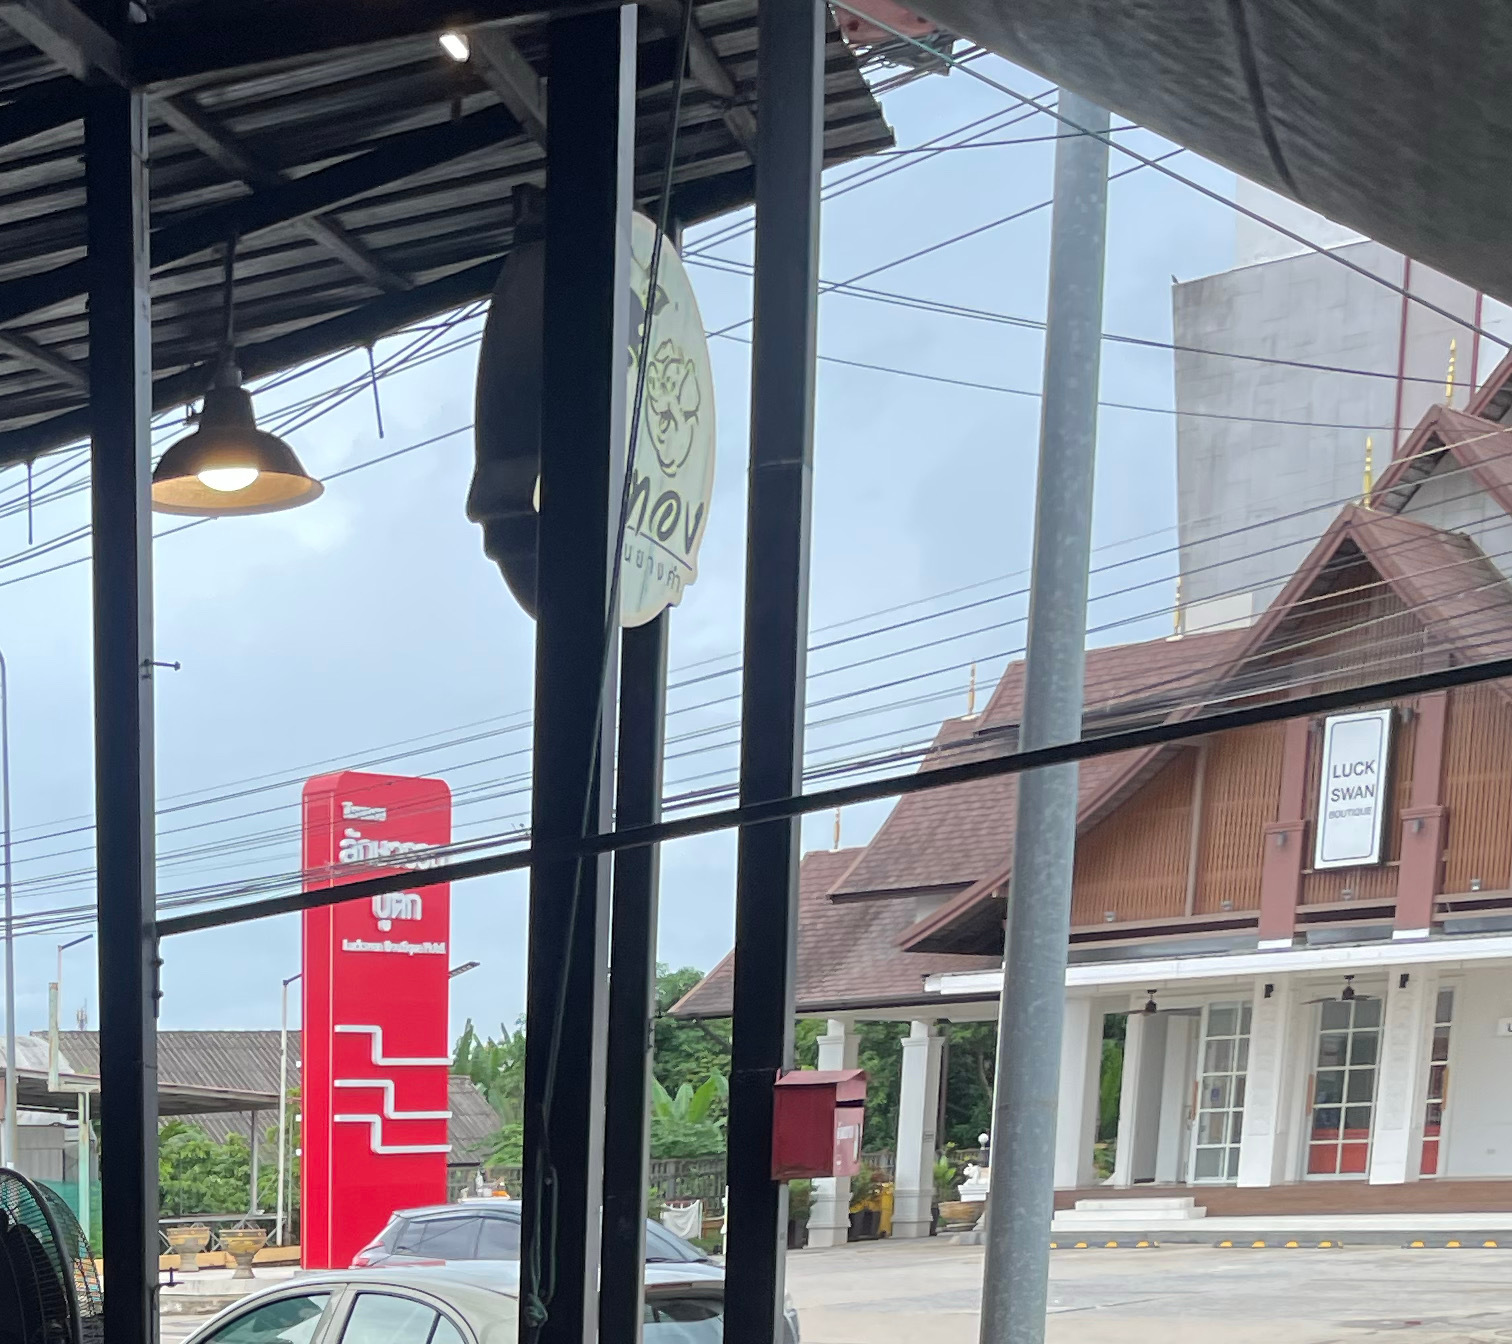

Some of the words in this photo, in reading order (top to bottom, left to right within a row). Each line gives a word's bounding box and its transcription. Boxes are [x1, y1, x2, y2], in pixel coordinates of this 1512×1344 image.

[1332, 759, 1376, 779] LUCK
[1330, 784, 1376, 803] SWAN
[1328, 806, 1372, 820] BOUTIQUE
